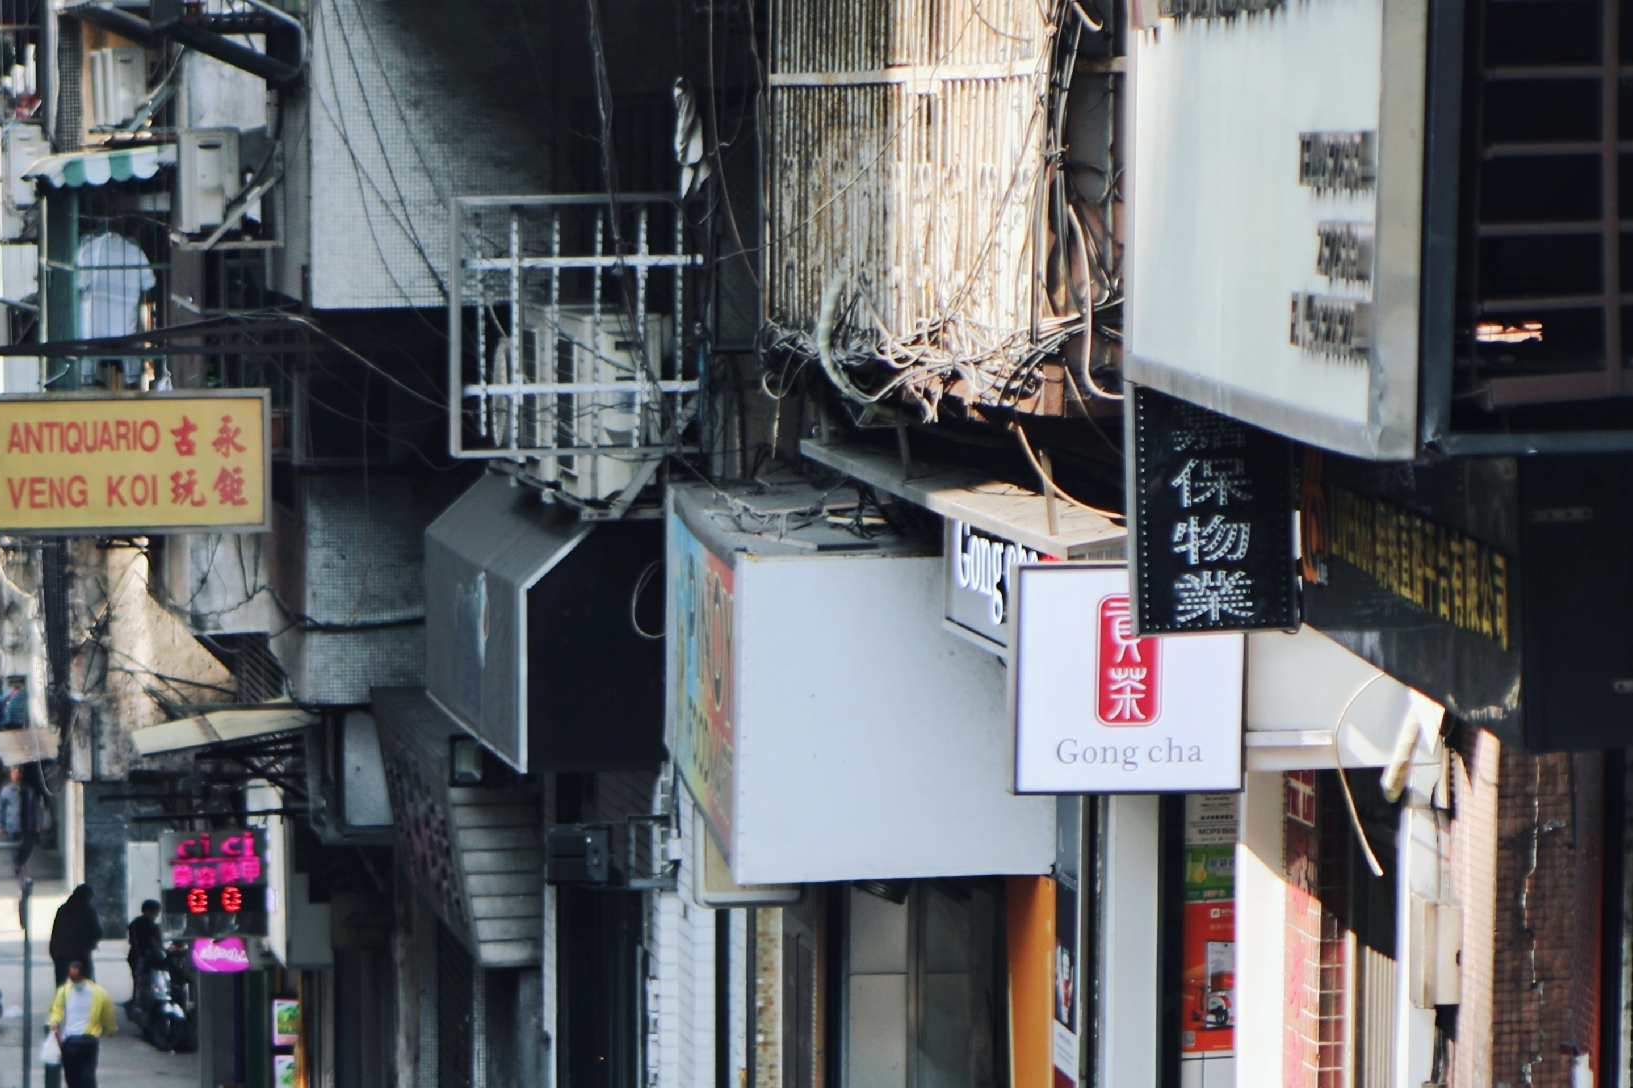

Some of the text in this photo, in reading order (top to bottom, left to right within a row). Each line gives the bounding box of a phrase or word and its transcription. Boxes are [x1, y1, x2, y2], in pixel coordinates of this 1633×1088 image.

[7, 419, 162, 455] ANTIQUARIO
[7, 474, 160, 510] VENG KOI
[1056, 736, 1203, 771] Gong cha
